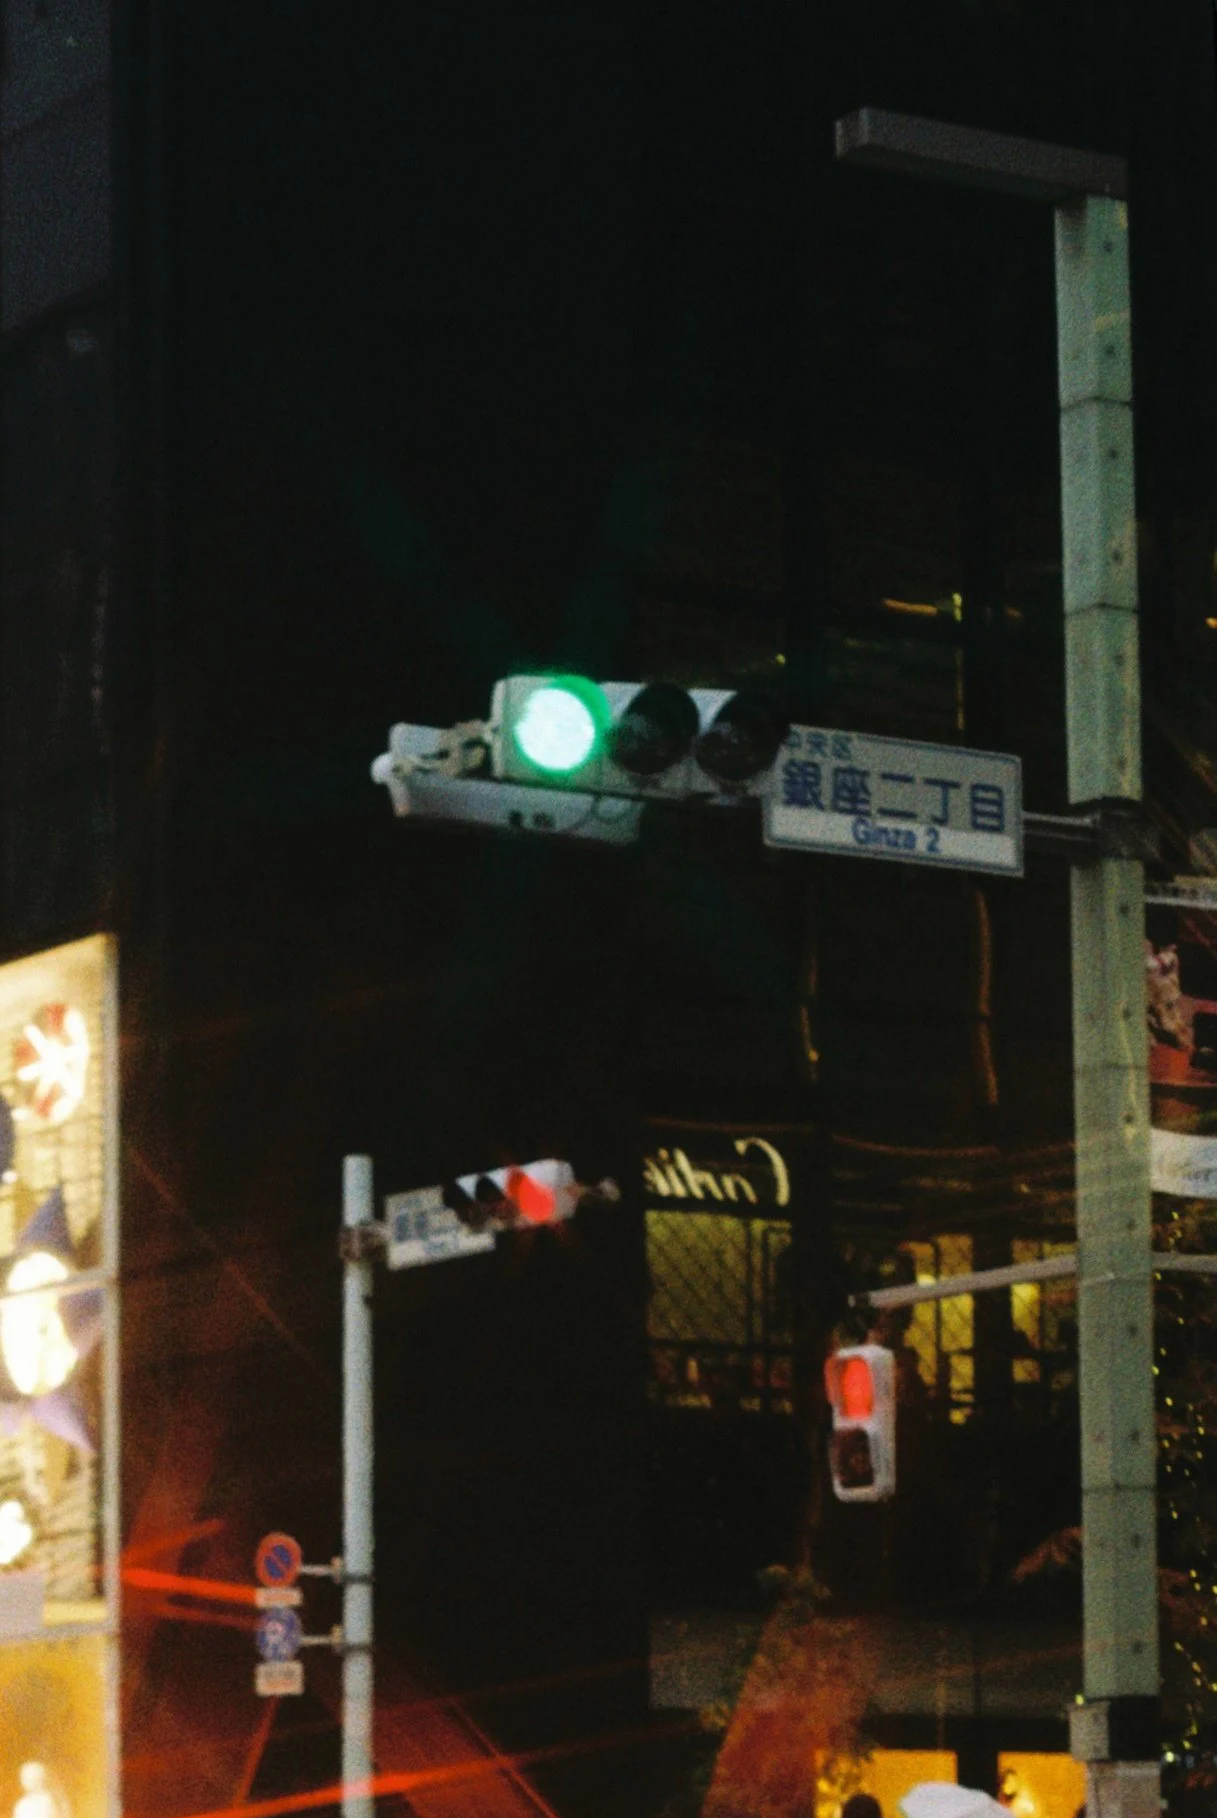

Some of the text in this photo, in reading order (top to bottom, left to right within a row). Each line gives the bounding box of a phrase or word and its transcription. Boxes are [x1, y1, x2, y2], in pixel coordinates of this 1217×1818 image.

[783, 758, 1004, 832] 銀座二丁目
[852, 817, 940, 853] Ginza 2
